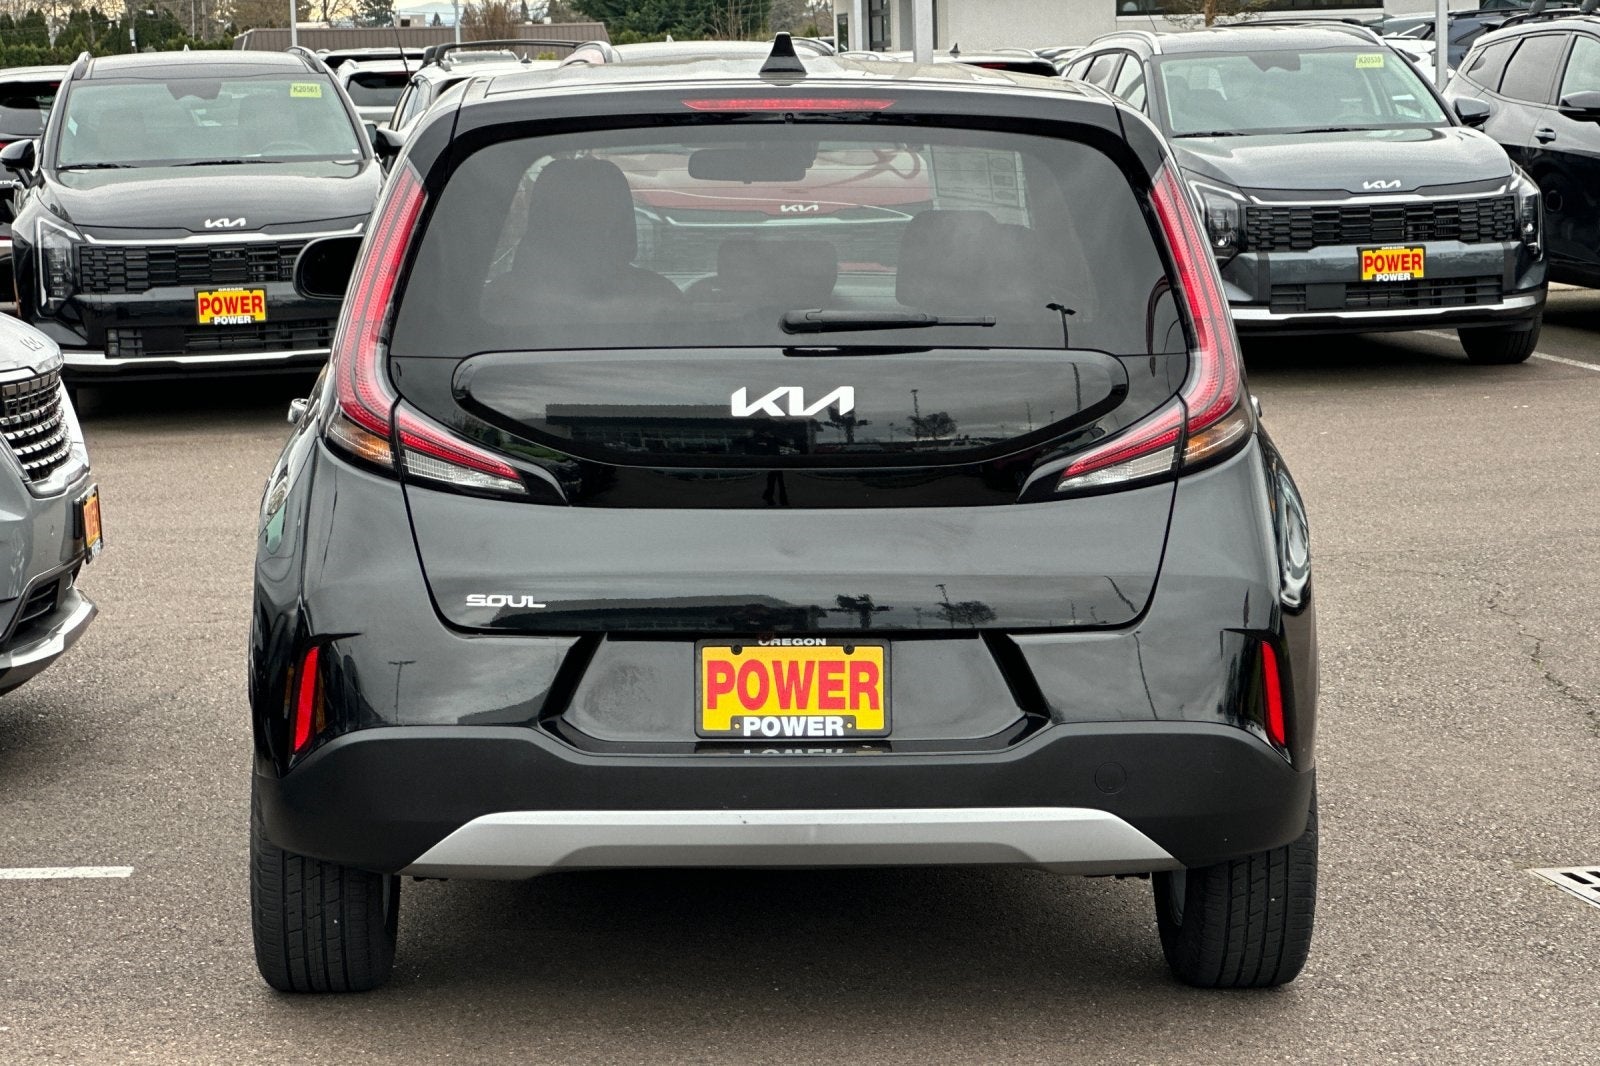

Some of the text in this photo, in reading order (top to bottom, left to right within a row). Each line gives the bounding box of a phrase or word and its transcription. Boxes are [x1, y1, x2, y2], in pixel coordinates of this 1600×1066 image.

[1362, 180, 1402, 190] KIA
[780, 204, 819, 212] KIA
[204, 217, 247, 228] KIA
[1363, 253, 1422, 273] POWER
[1376, 273, 1411, 281] POWER
[200, 295, 263, 316] POWER
[214, 315, 251, 325] POWER
[731, 385, 855, 417] KIA
[465, 593, 547, 608] SOUL
[758, 638, 827, 646] OREGON
[707, 659, 880, 711] POWER
[743, 716, 844, 737] POWER
